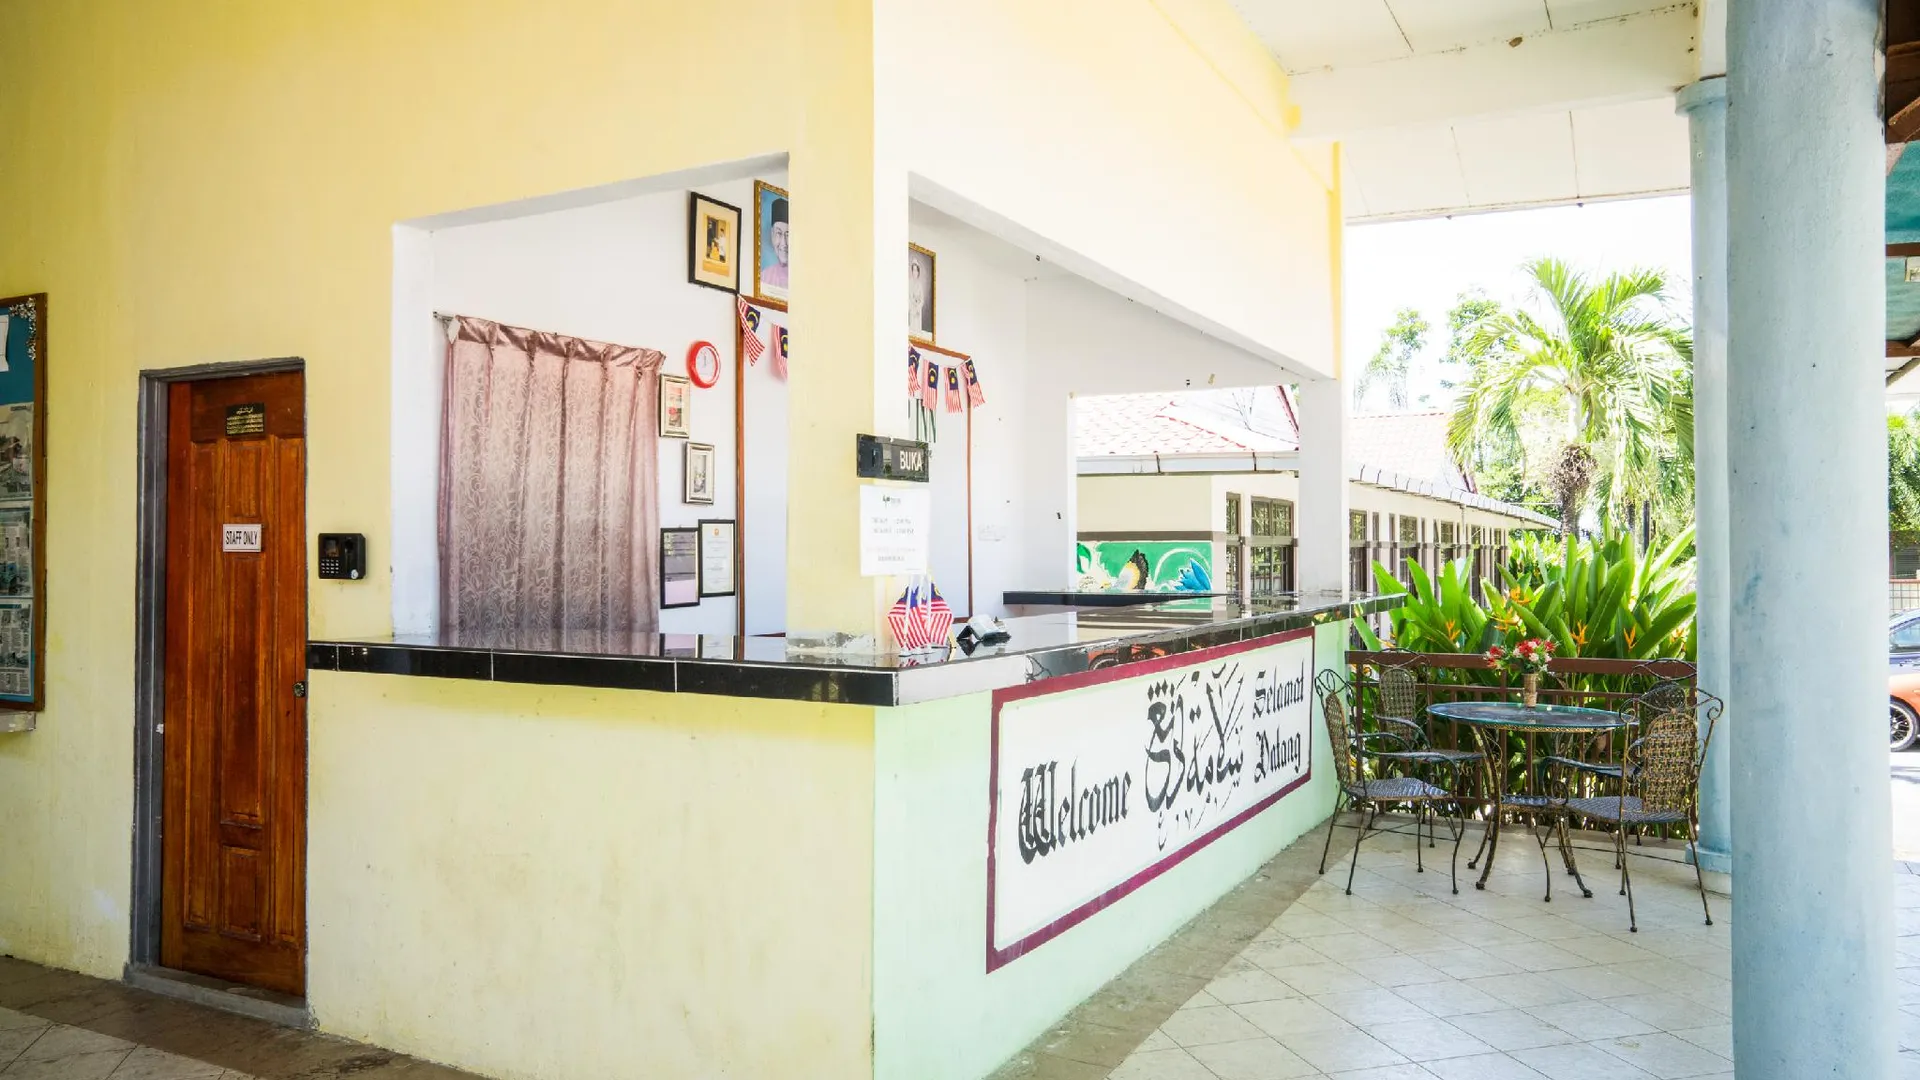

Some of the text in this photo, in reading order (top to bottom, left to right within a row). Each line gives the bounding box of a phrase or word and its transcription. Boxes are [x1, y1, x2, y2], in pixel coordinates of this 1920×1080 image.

[899, 450, 923, 472] BUKA
[225, 530, 258, 546] STAFF ONLY
[1252, 661, 1305, 720] Selamat
[1253, 729, 1302, 784] Datang
[1018, 757, 1132, 865] Welcome
